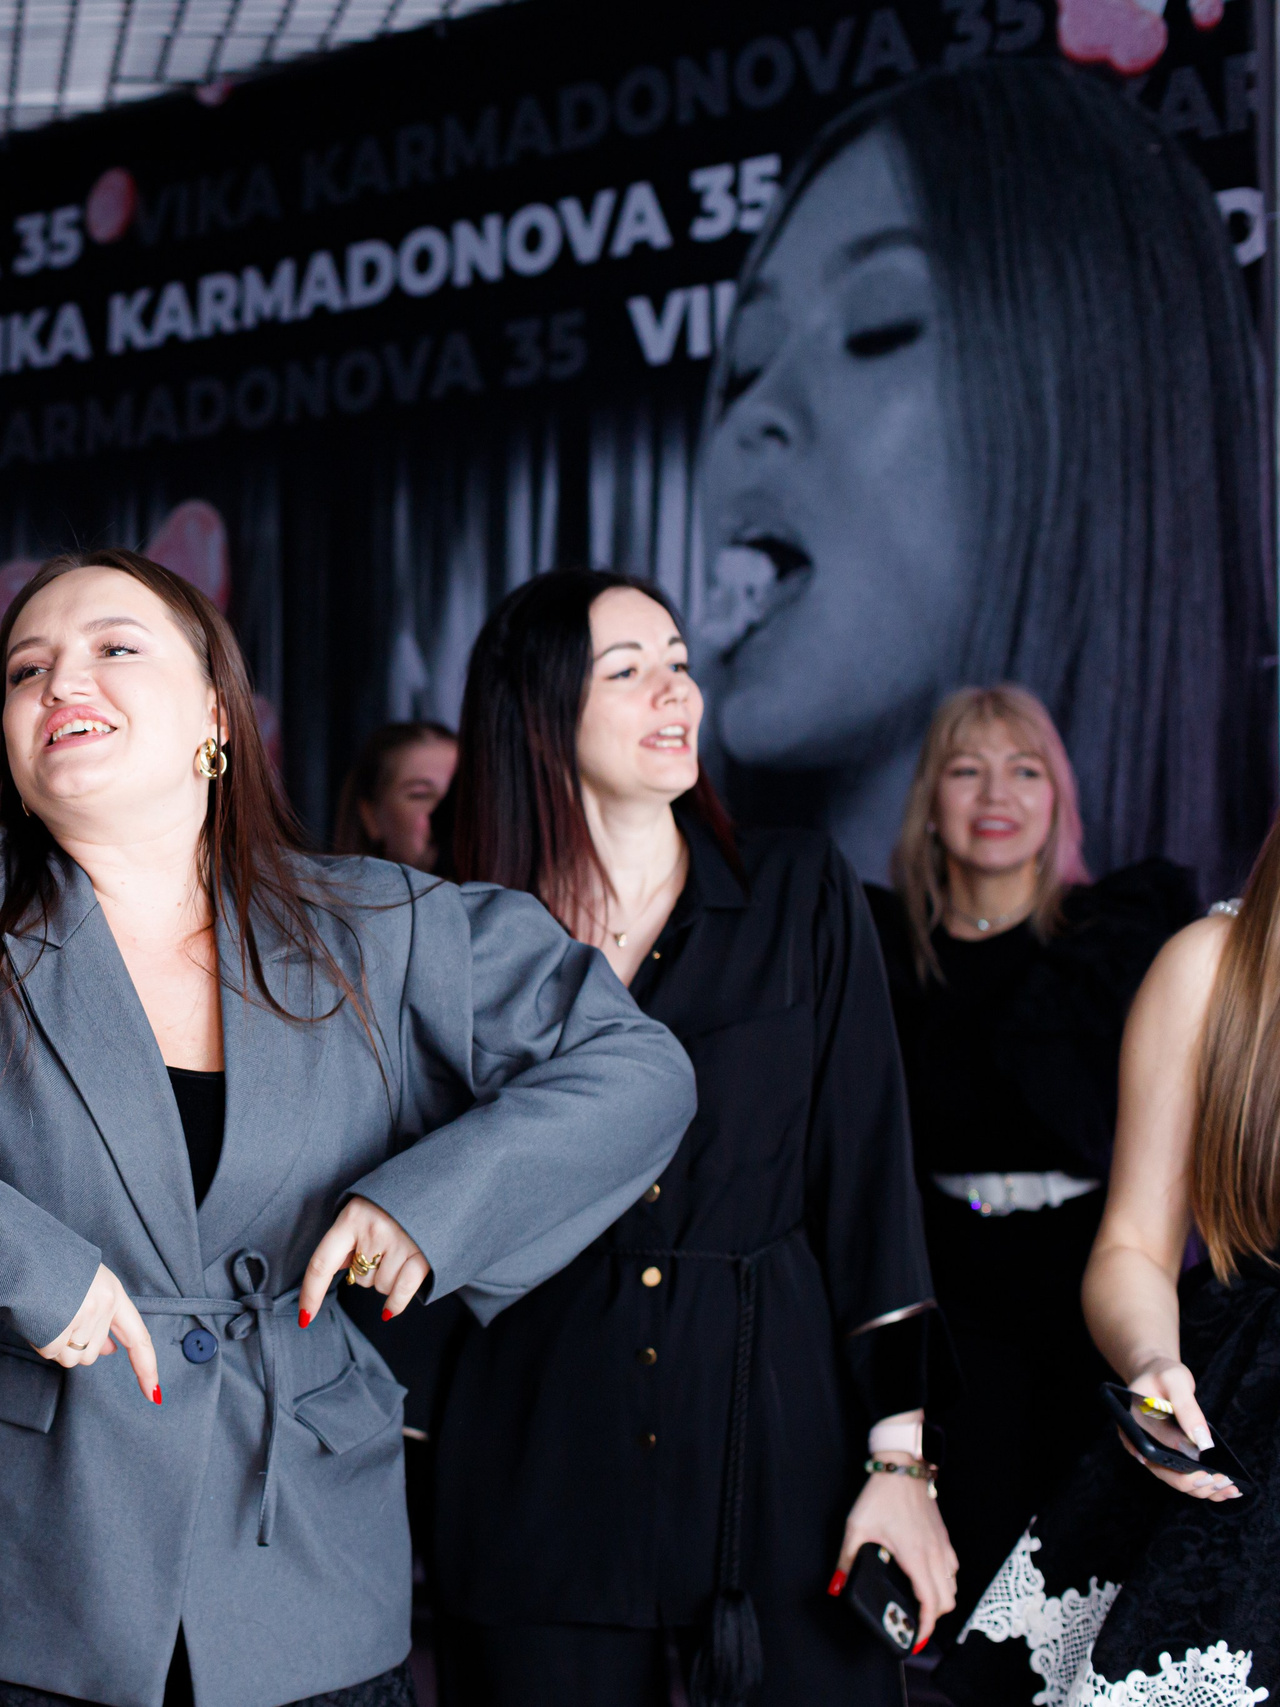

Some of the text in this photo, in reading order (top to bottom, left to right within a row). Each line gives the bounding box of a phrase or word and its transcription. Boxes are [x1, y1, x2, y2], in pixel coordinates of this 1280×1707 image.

[135, 162, 285, 248] VIKA
[299, 6, 918, 210] KARMADONOVA
[10, 203, 85, 279] 35
[105, 179, 674, 357] KARMADONOVA
[688, 153, 783, 242] 35
[501, 308, 590, 389] 35
